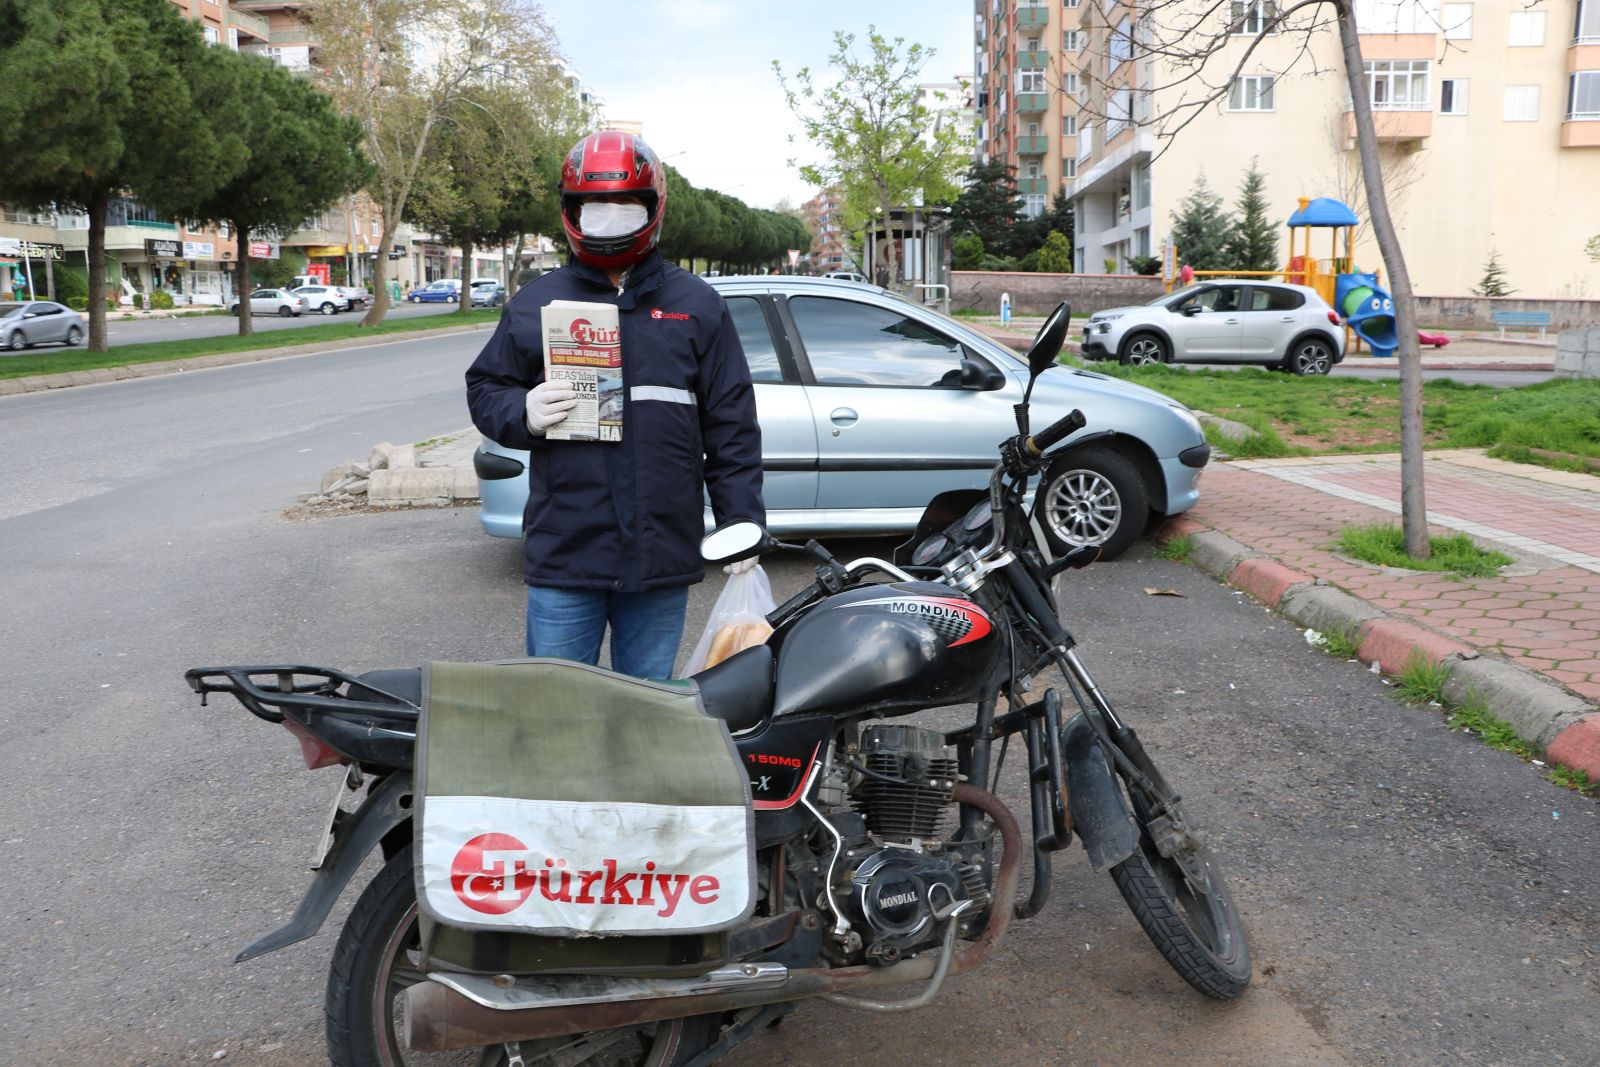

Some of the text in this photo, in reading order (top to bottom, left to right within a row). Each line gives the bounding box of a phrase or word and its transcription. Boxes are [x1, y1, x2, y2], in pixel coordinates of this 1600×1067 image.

[891, 601, 970, 622] MONDIAL
[748, 754, 801, 768] 150MG
[478, 847, 720, 917] Türkiye
[879, 891, 918, 909] MONDIAL
